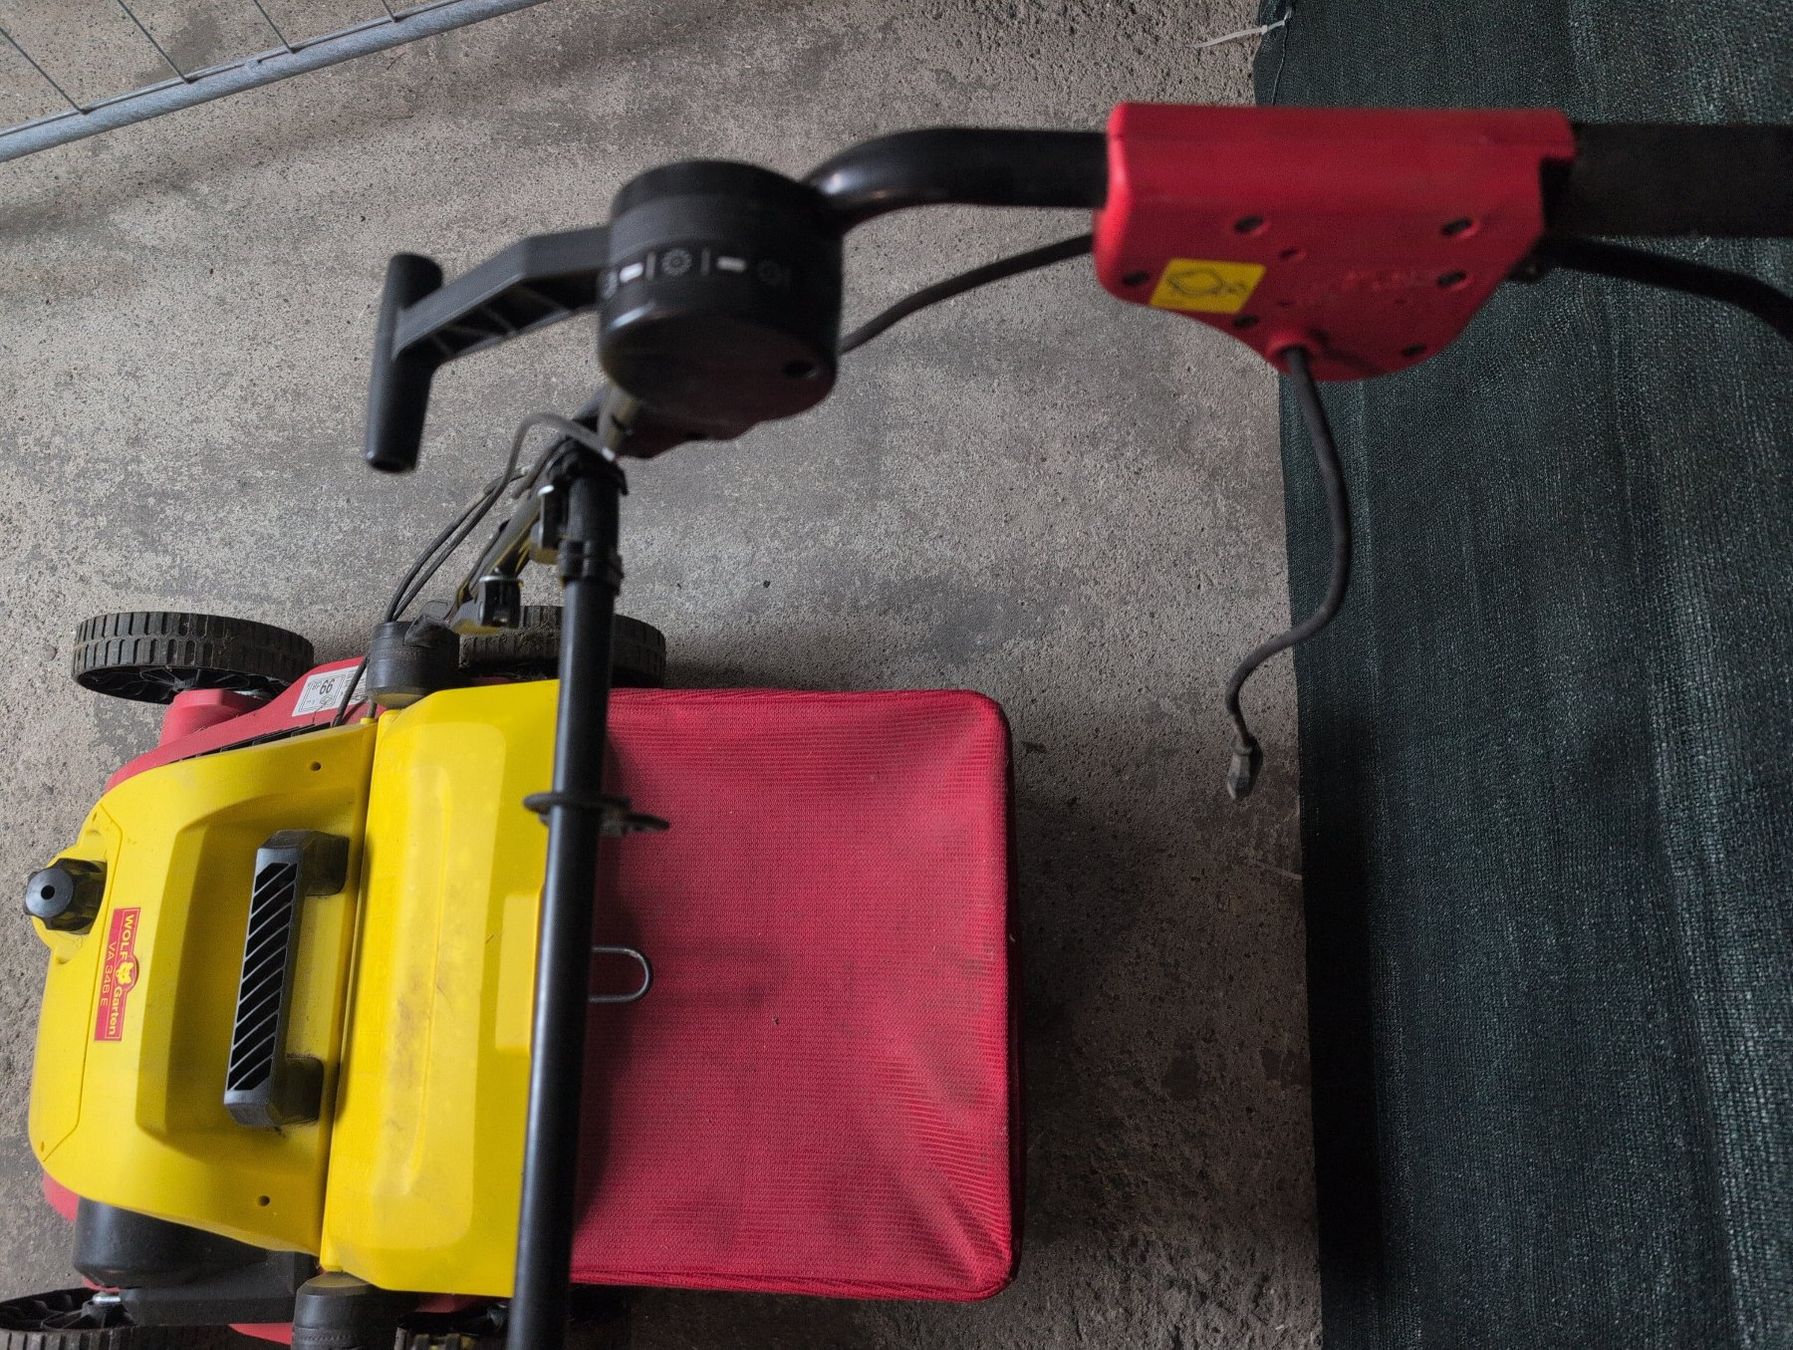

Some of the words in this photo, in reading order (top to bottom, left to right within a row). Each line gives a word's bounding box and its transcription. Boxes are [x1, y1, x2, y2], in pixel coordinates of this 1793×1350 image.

[107, 942, 117, 960] VA
[120, 914, 134, 960] WOLF
[100, 997, 109, 1007] E
[109, 986, 122, 1035] Garten
